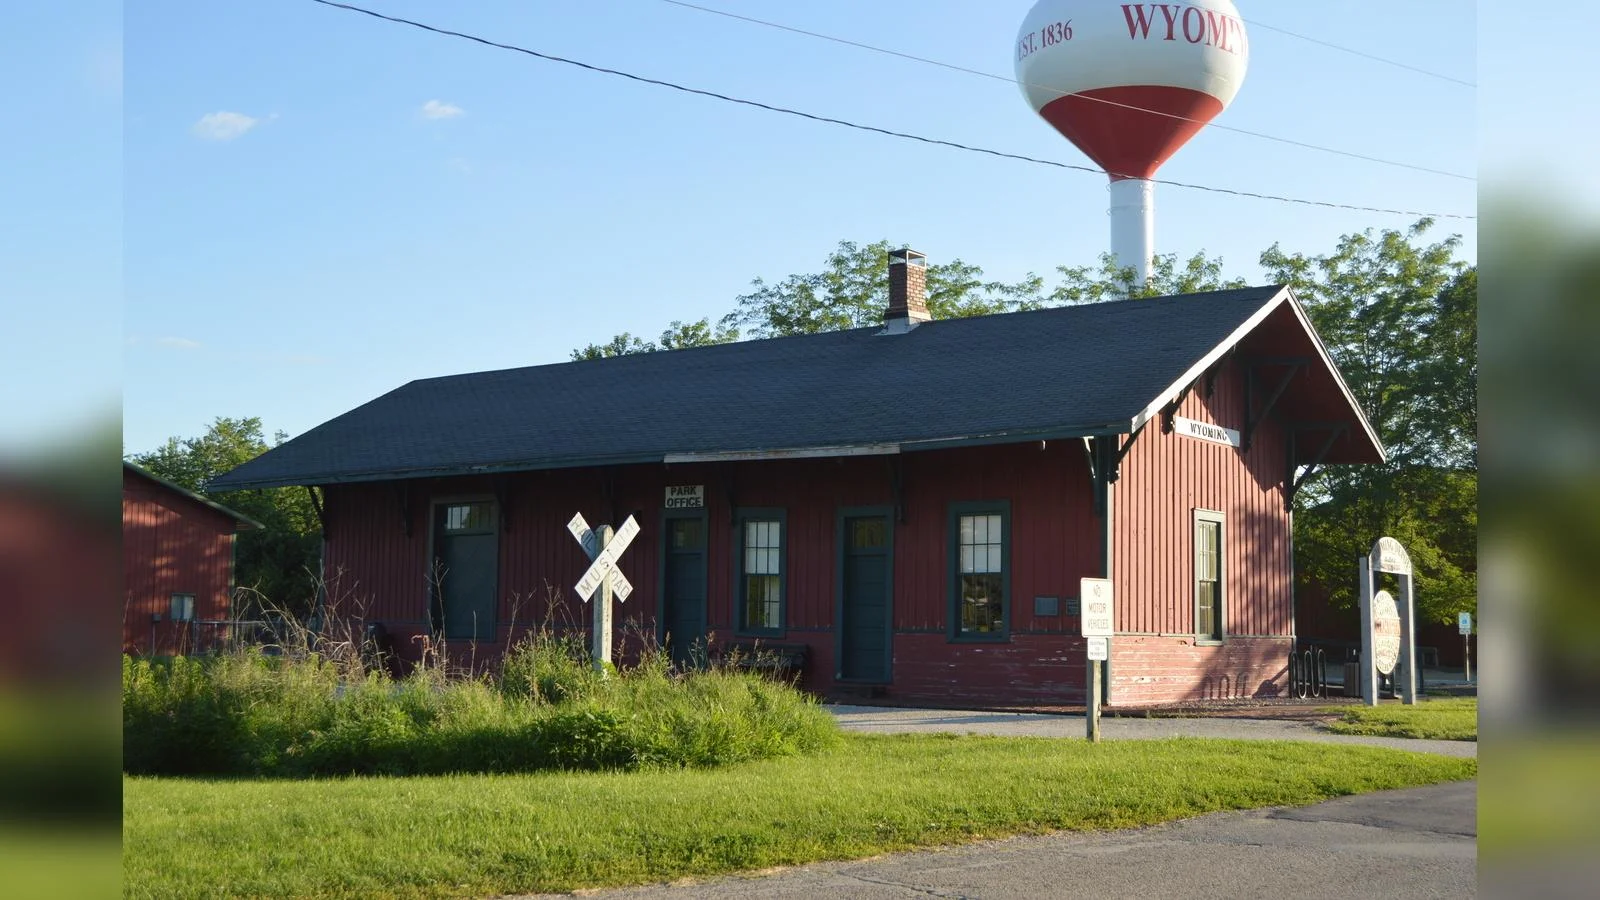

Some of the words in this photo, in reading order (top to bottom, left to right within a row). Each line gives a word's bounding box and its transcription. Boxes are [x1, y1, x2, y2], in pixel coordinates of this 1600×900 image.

[1041, 18, 1073, 49] 1836
[670, 486, 697, 496] PARK
[666, 497, 702, 507] OFFICE
[1088, 602, 1107, 614] MOTOR
